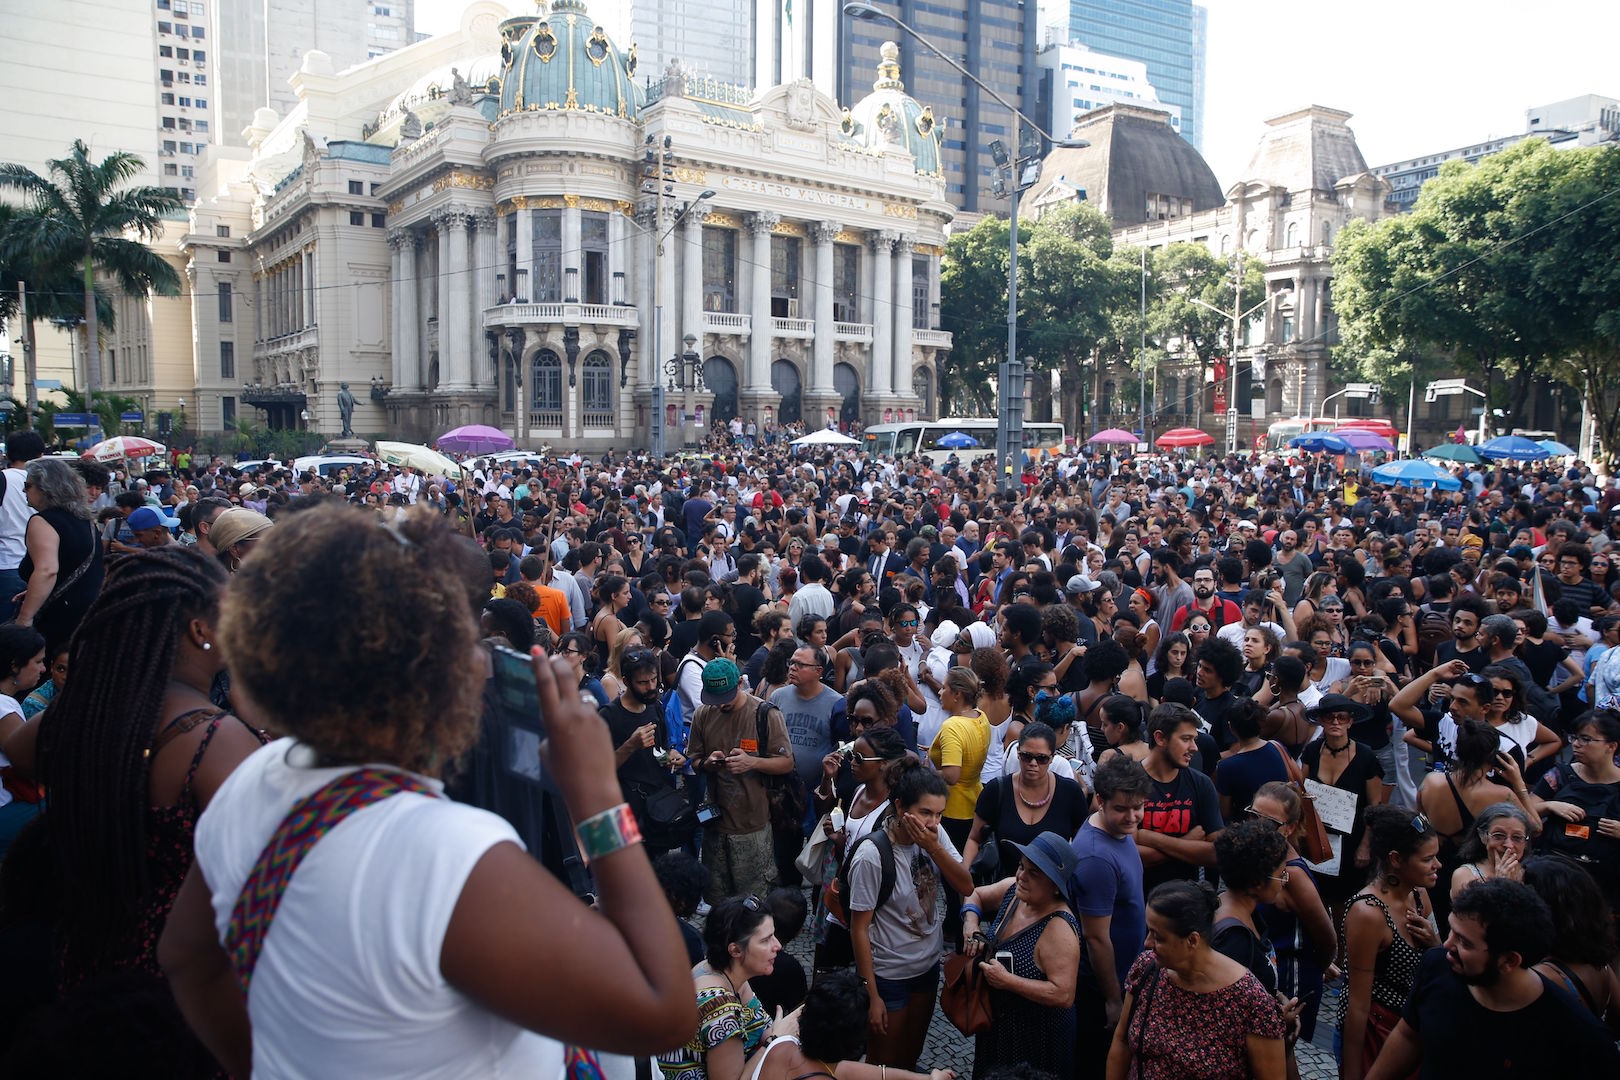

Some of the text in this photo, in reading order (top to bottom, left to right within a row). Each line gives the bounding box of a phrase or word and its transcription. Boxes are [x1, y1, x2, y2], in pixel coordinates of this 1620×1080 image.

[733, 178, 862, 209] THEATRO MUNICIPAL
[785, 712, 823, 736] RIZONA
[1143, 808, 1190, 833] 1981
